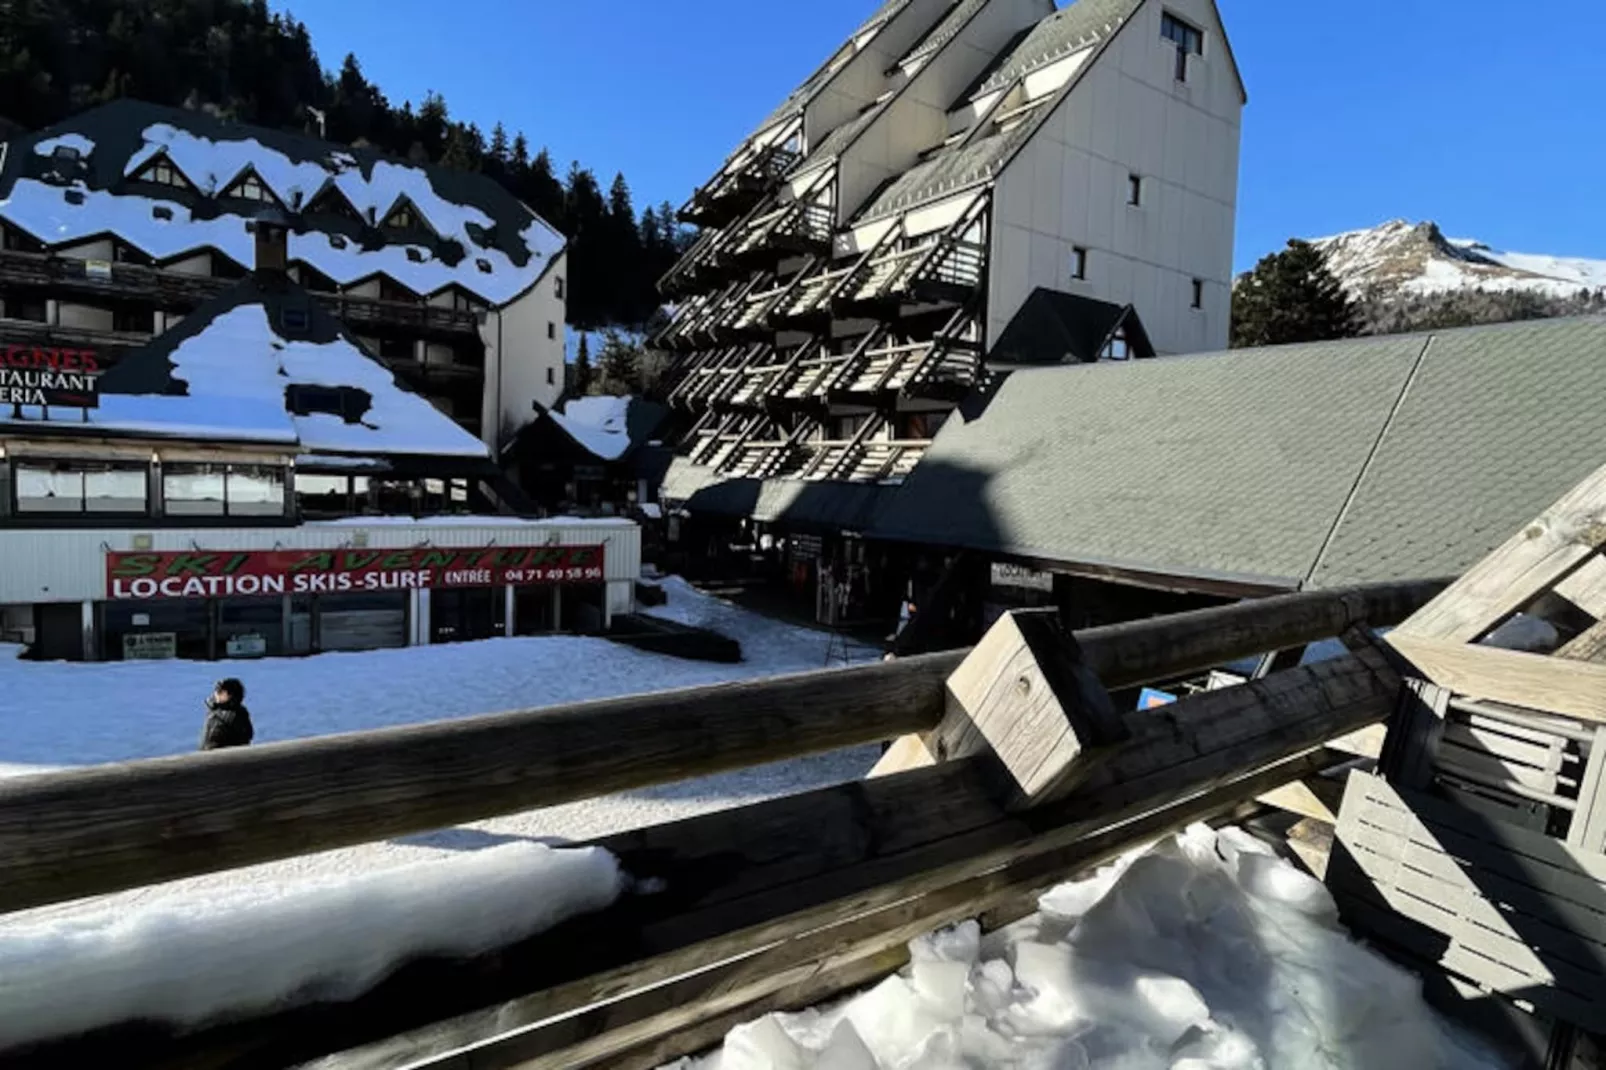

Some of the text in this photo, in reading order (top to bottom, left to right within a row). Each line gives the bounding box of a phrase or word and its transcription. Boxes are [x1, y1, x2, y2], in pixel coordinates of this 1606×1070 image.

[0, 344, 98, 372] GNES
[0, 386, 47, 405] ERIA
[111, 549, 600, 577] SKI AVENTURE
[504, 569, 524, 581] 04
[527, 568, 542, 581] 71
[546, 568, 564, 580] 49
[113, 569, 432, 599] LOCATION SKIS-SURF
[444, 567, 491, 584] ENTRÉE
